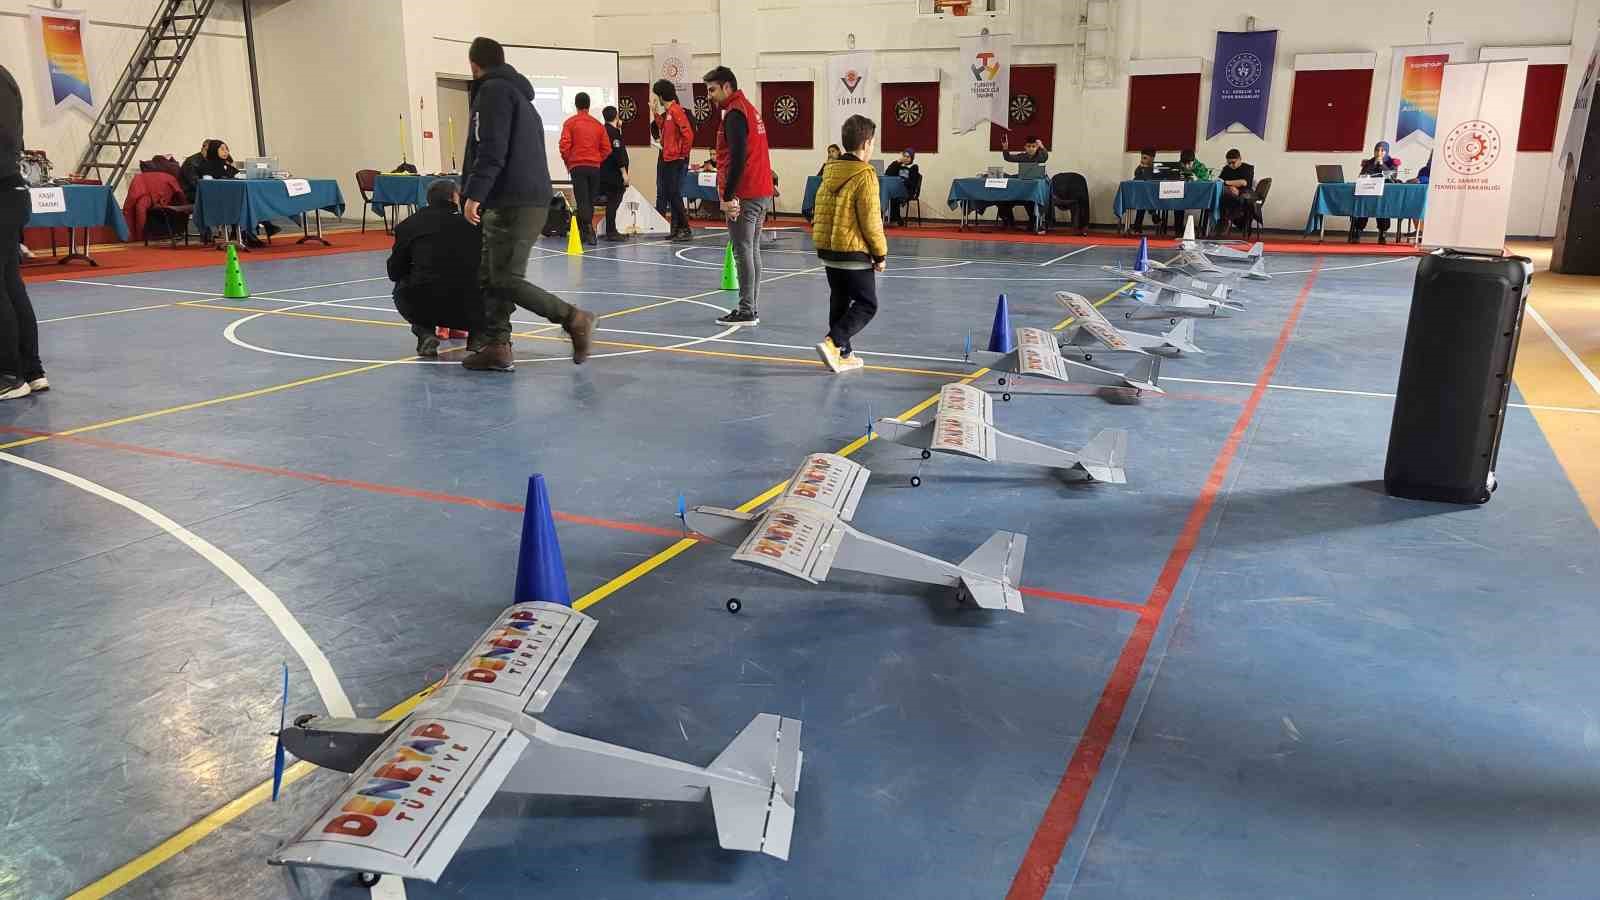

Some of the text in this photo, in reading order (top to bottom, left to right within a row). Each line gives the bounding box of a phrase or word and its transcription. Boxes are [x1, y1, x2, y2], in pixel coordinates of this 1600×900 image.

[462, 611, 538, 684] DENEYAP
[509, 623, 553, 675] TÜRKİYE
[322, 723, 450, 837] DENEYAP
[395, 743, 470, 822] TÜRKİYE
